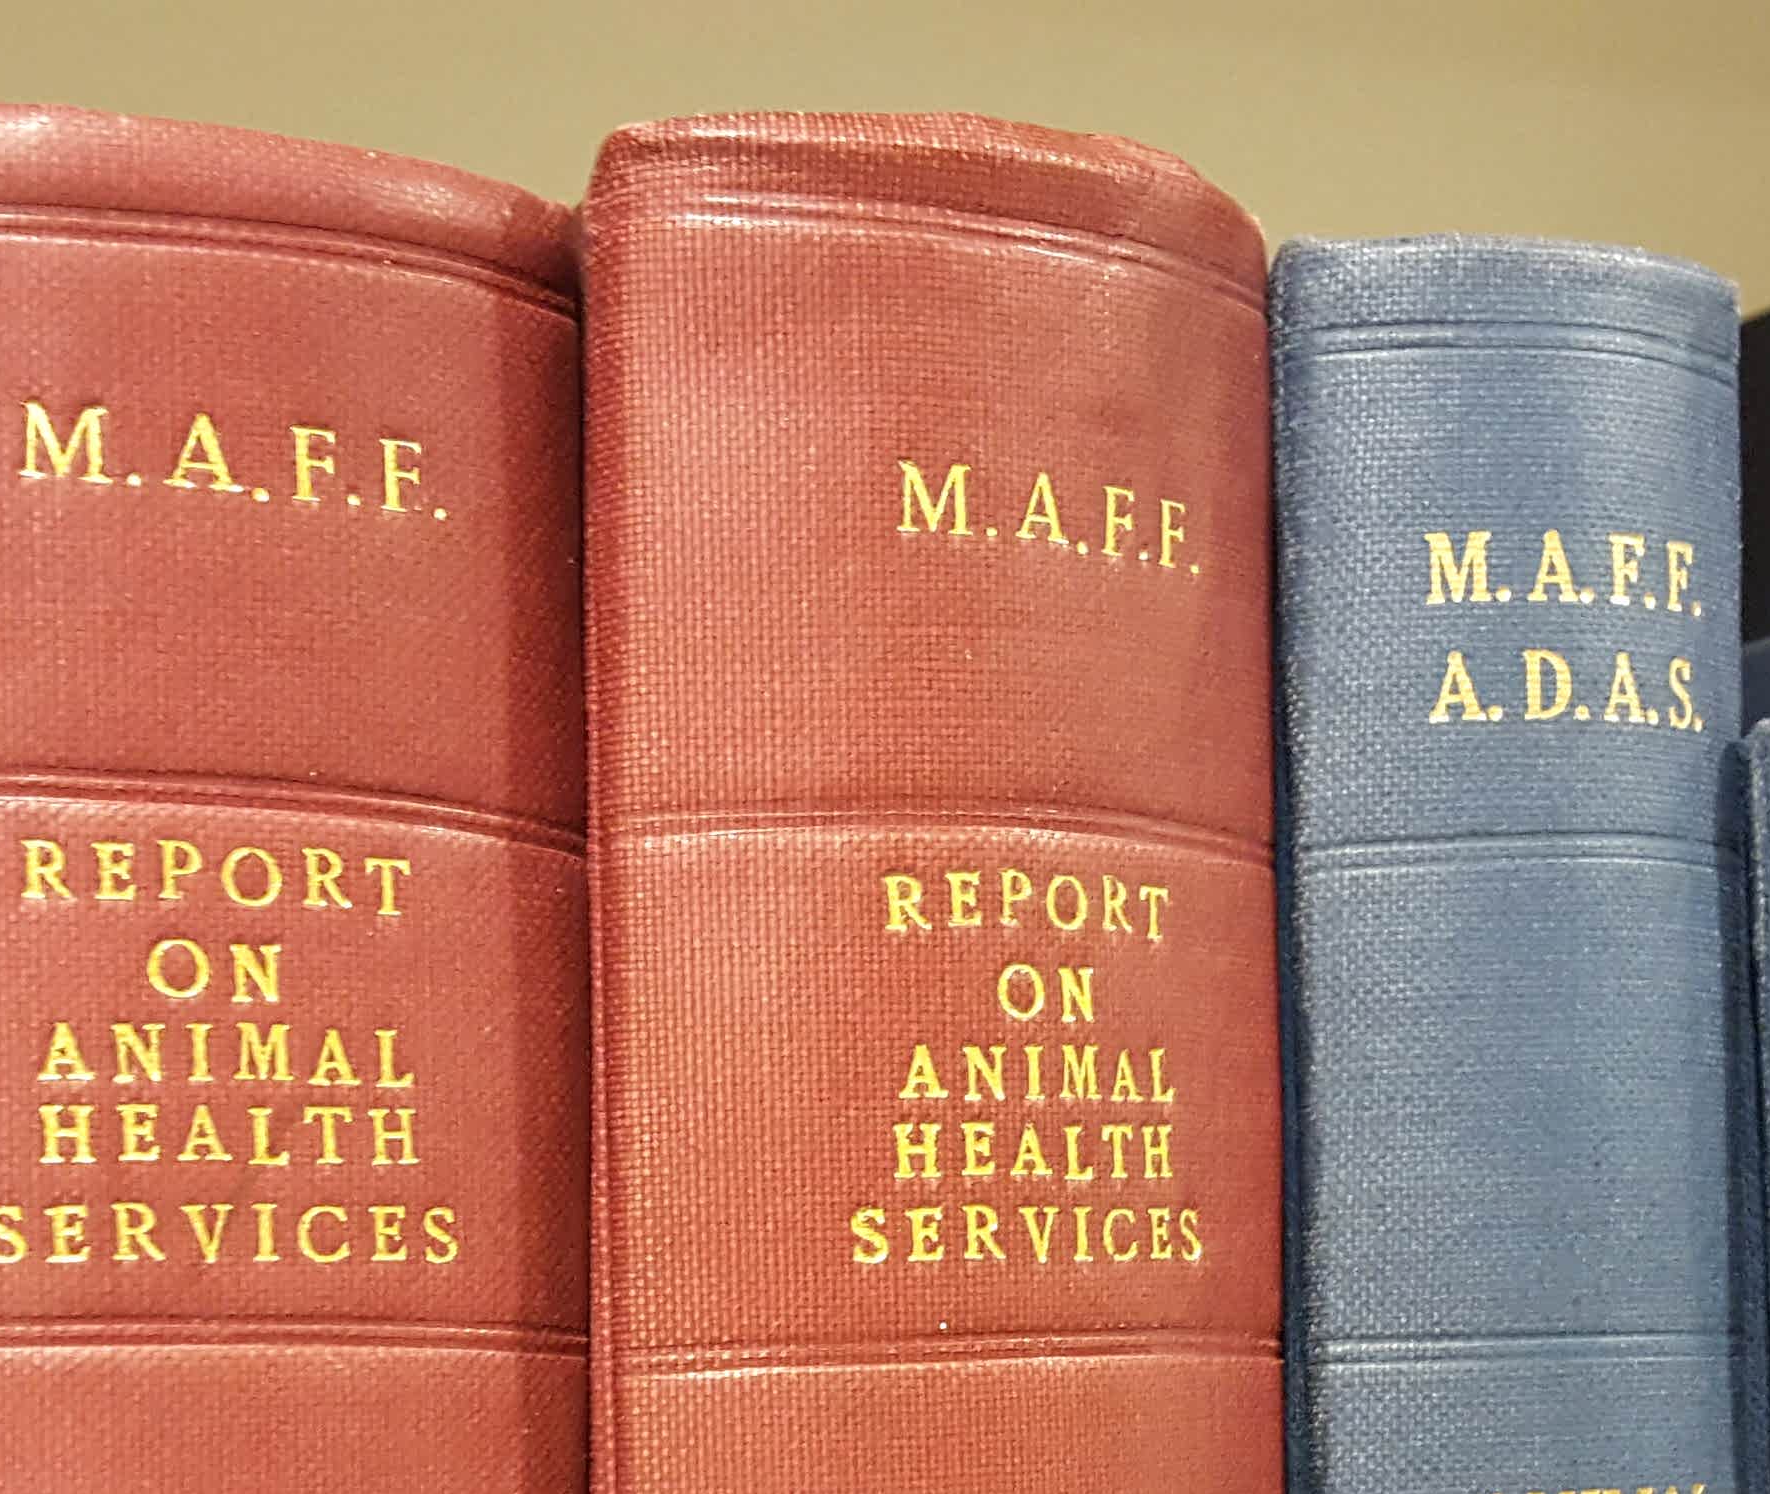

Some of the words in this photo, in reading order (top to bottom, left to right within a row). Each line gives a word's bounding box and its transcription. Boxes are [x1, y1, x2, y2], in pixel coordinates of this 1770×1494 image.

[1423, 528, 1702, 618] M.A.F.F.
[1428, 647, 1705, 734] A.D.A.S.
[20, 838, 412, 916] REPORT
[882, 868, 1170, 941] REPORT
[146, 938, 283, 1004] ON
[996, 962, 1095, 1024] ON
[37, 1021, 416, 1089] ANIMAL
[897, 1042, 1177, 1105] ANIMAL
[37, 1103, 421, 1167] HEALTH
[892, 1120, 1174, 1182] HEALTH
[849, 1203, 1204, 1266] SERVICES
